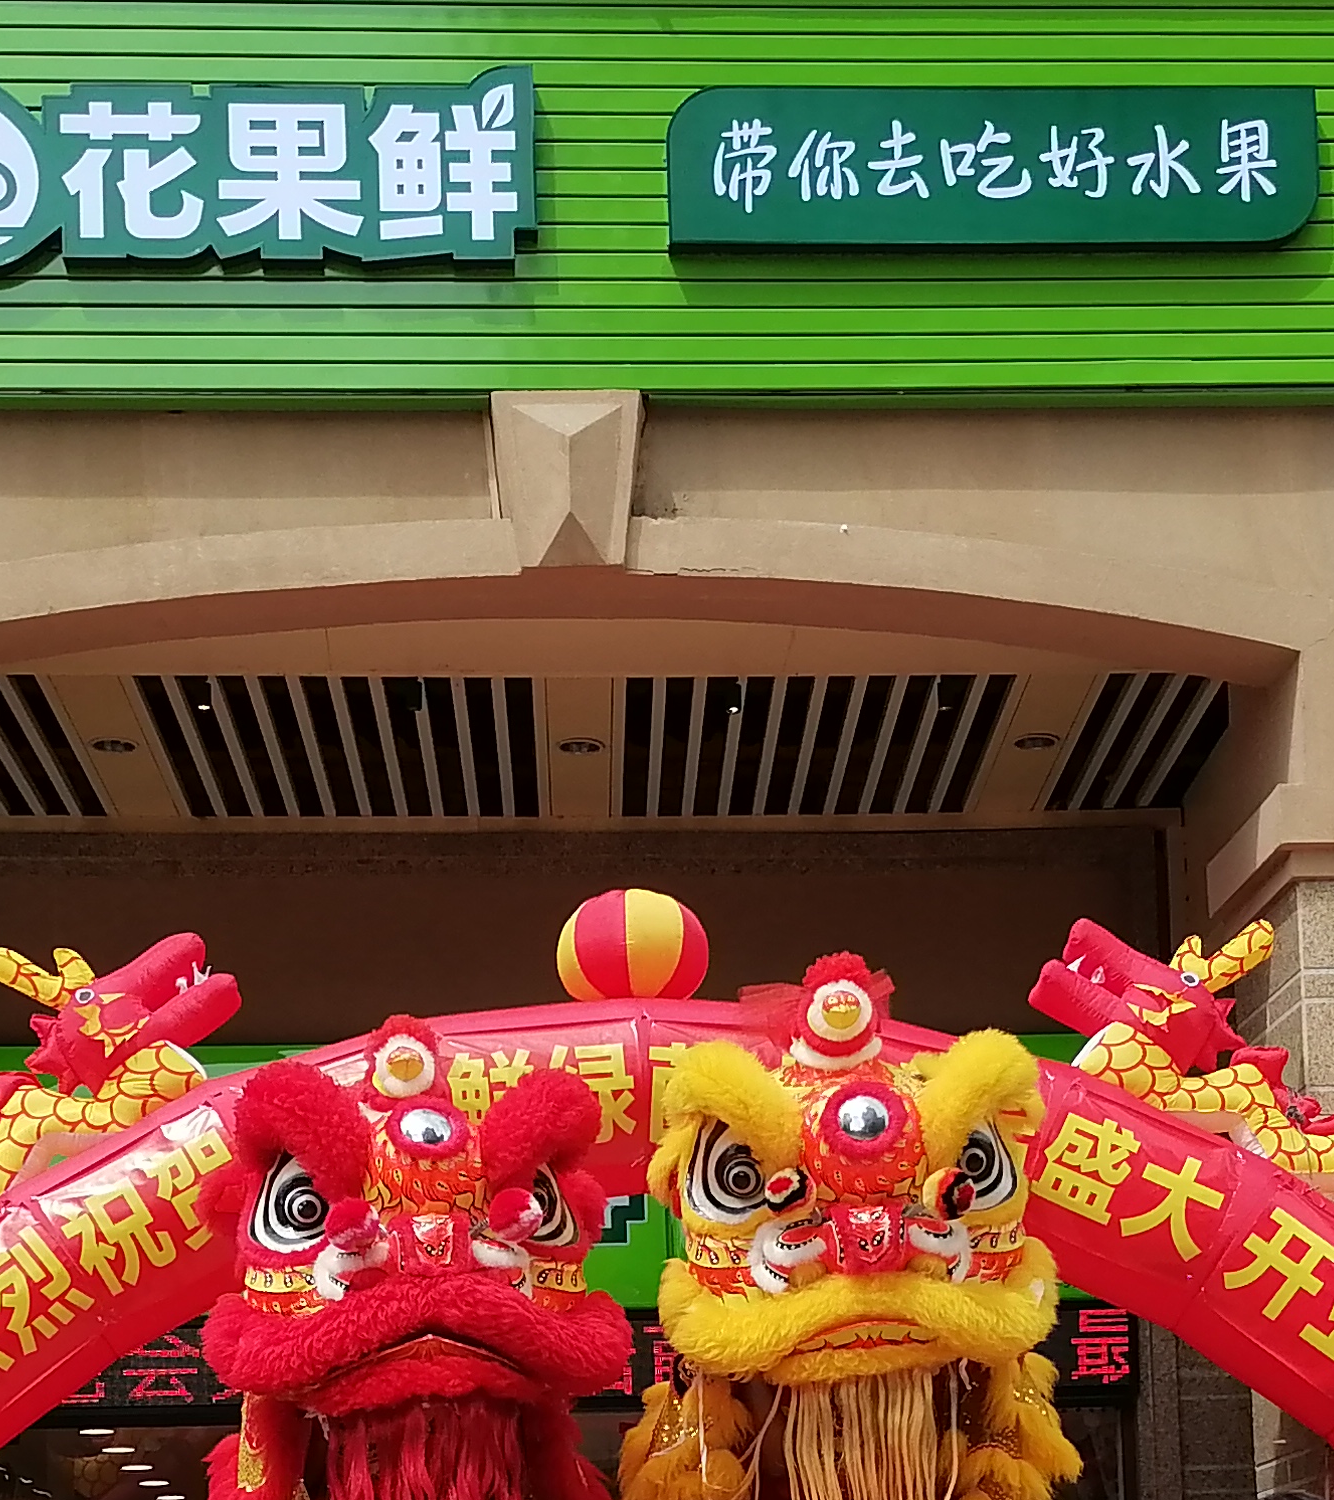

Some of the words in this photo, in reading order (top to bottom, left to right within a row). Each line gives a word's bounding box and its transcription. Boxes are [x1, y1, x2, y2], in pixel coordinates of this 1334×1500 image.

[59, 83, 519, 242] 花果鲜
[713, 119, 1278, 213] 带你去吃好水果
